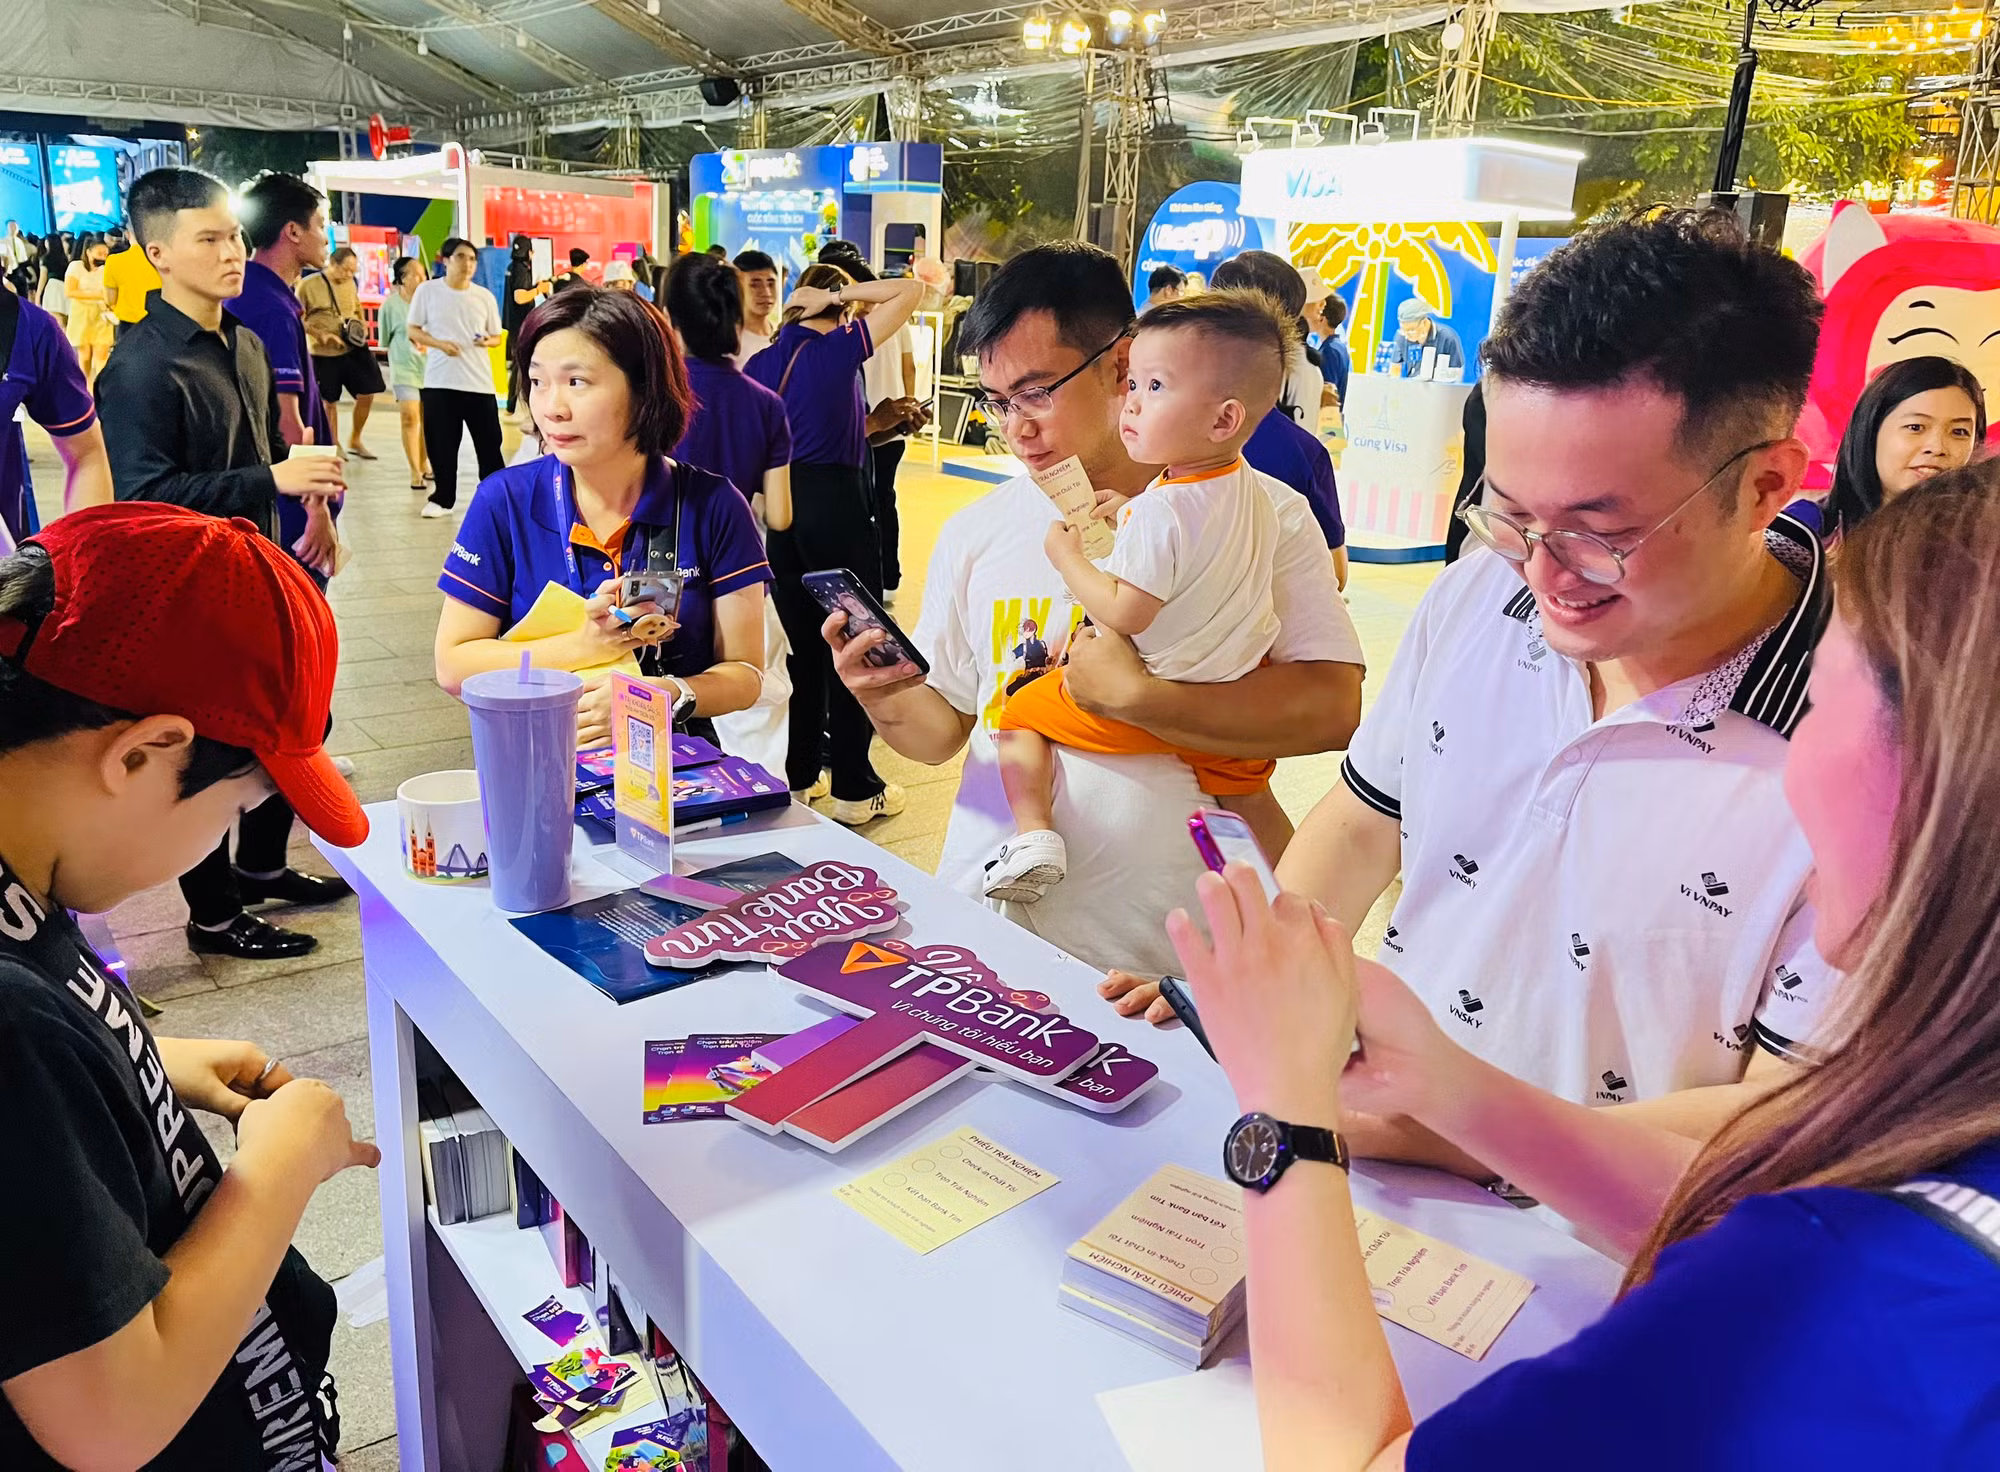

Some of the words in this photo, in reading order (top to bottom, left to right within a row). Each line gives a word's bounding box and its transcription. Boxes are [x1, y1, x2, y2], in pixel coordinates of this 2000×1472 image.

[1384, 439, 1408, 454] Visa
[1518, 659, 1543, 673] VNPAY
[1679, 729, 1716, 754] VNPAY
[1449, 869, 1477, 889] VNSKY
[1694, 891, 1733, 917] VNPAY
[889, 964, 1074, 1049] TPBank
[1450, 1004, 1482, 1029] VNSKY
[908, 1007, 959, 1034] chúng
[958, 1023, 986, 1042] tôi
[982, 1033, 1022, 1056] hiểu
[1019, 1047, 1055, 1069] bạn
[1078, 1076, 1117, 1098] bạn
[1168, 1202, 1191, 1214] Bank
[1131, 1269, 1159, 1287] TRẢI
[1160, 1282, 1194, 1302] PHIẾU
